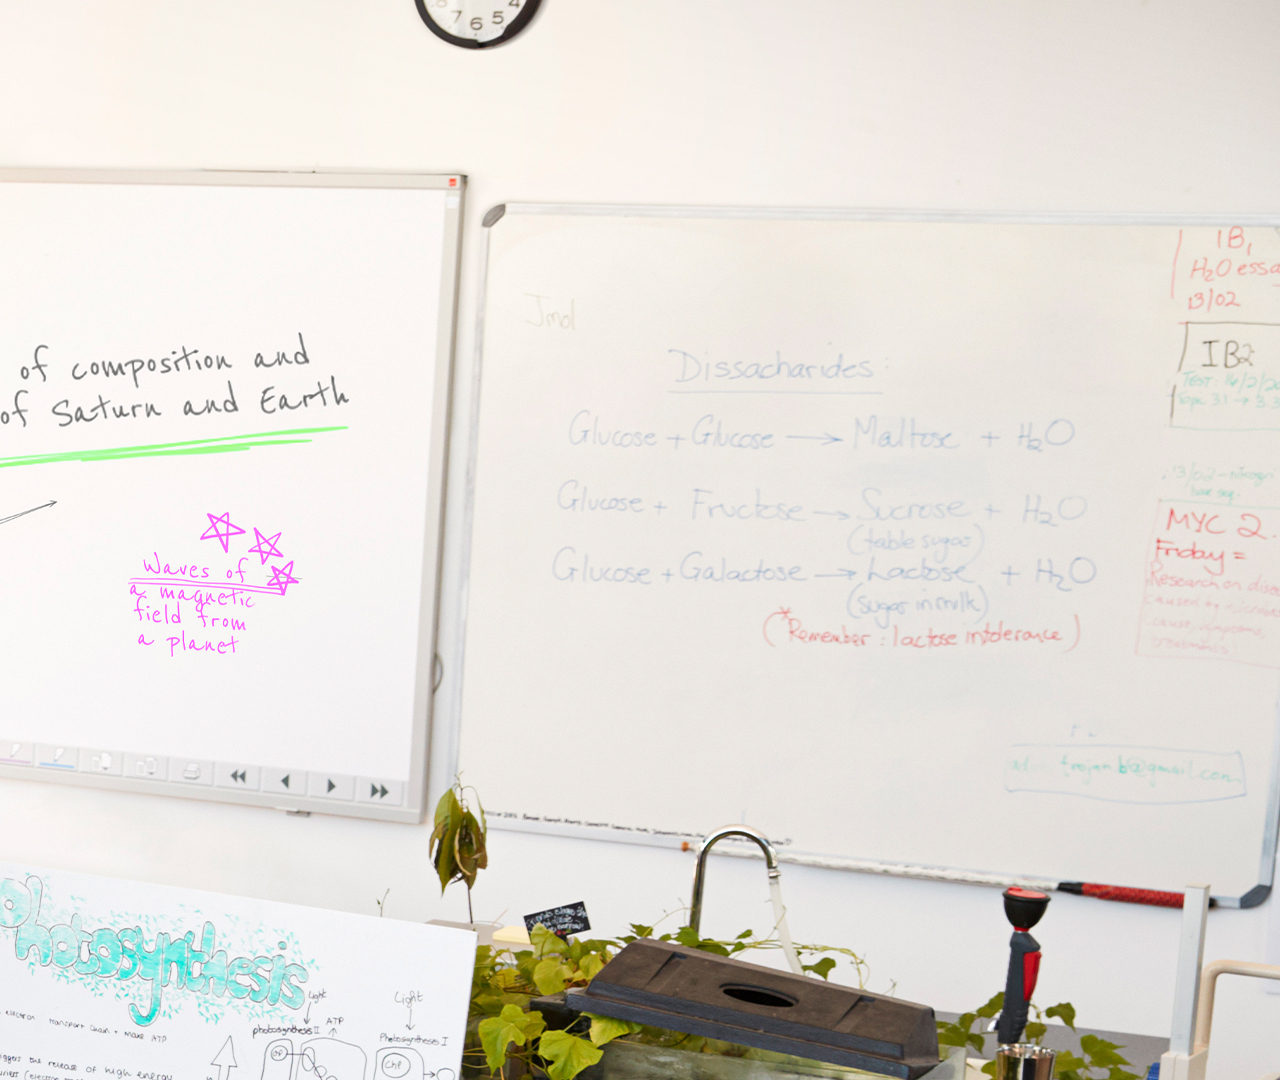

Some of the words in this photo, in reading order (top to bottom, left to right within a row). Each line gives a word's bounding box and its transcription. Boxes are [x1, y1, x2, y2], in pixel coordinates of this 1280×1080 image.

[452, 10, 462, 24] 7
[470, 18, 483, 30] 6
[492, 11, 504, 24] 5
[19, 345, 49, 382] of
[72, 350, 232, 389] composition
[254, 333, 310, 368] and
[0, 391, 29, 427] of
[52, 397, 162, 427] Saturn
[183, 382, 239, 416] and
[261, 377, 349, 414] Earth
[569, 408, 658, 450] Glucose
[692, 413, 776, 450] Glucose
[852, 415, 960, 449] Maltose
[558, 479, 643, 516] Glucose
[692, 487, 807, 524] Fructose
[856, 487, 972, 520] Sucrose
[1167, 508, 1226, 534] MYC
[143, 552, 211, 578] Waves
[226, 559, 249, 583] of
[553, 546, 651, 585] Glucose
[680, 551, 807, 585] Galactose
[868, 556, 976, 582] Lactose
[1156, 538, 1225, 576] Friday
[130, 582, 147, 597] a
[160, 584, 256, 611] magnetic
[134, 598, 183, 625] field
[198, 609, 247, 633] from
[893, 614, 958, 647] lactose
[137, 631, 154, 648] a
[168, 633, 240, 657] planet
[308, 989, 327, 1002] Light
[395, 991, 423, 1007] Light
[326, 1016, 344, 1025] ATP
